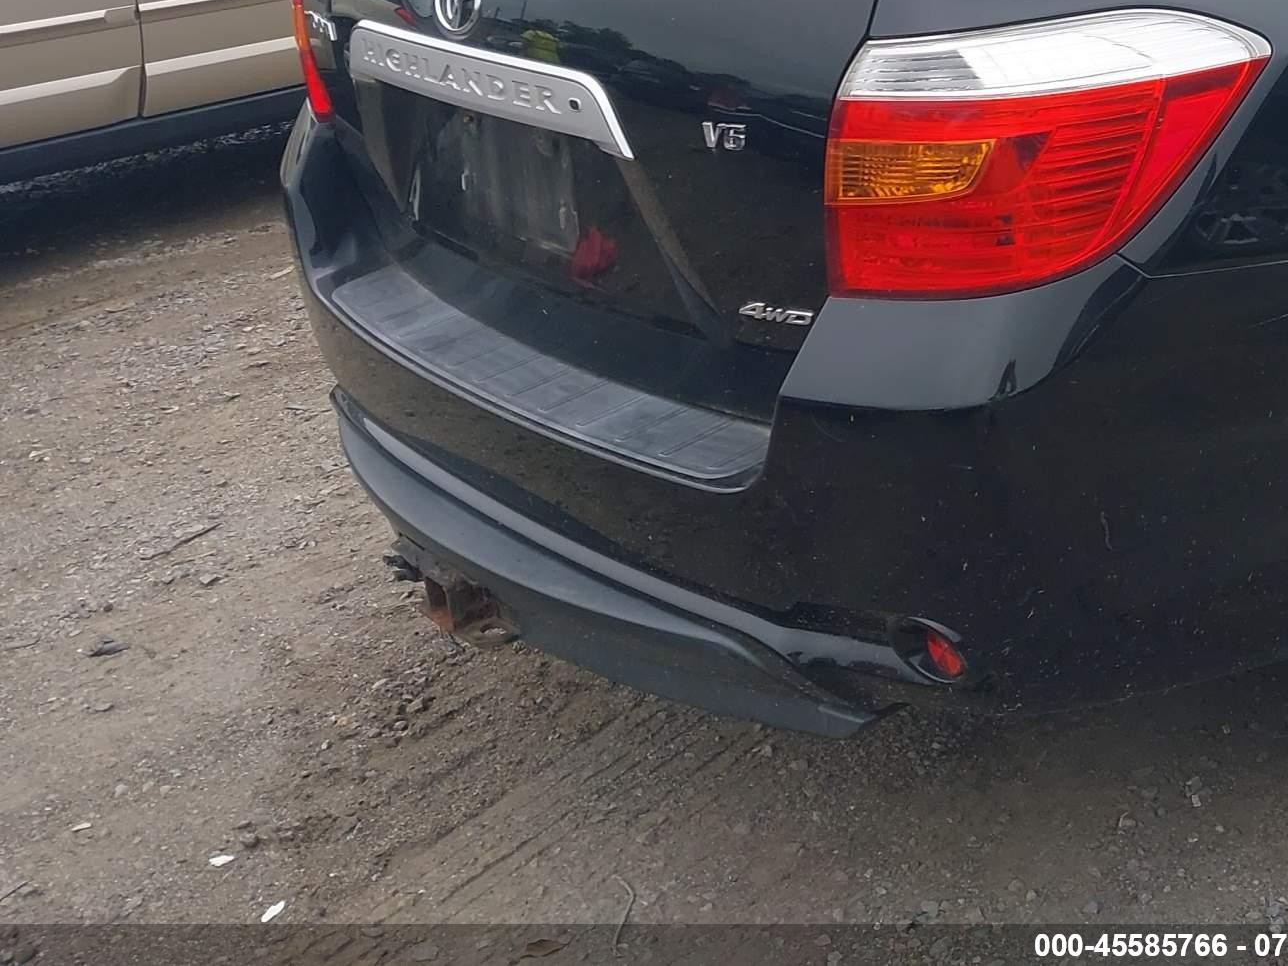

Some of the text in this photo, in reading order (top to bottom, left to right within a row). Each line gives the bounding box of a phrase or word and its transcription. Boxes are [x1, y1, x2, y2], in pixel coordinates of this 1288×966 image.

[361, 38, 562, 115] HIGHLANDER
[702, 122, 746, 151] V6
[739, 302, 814, 326] 4WD
